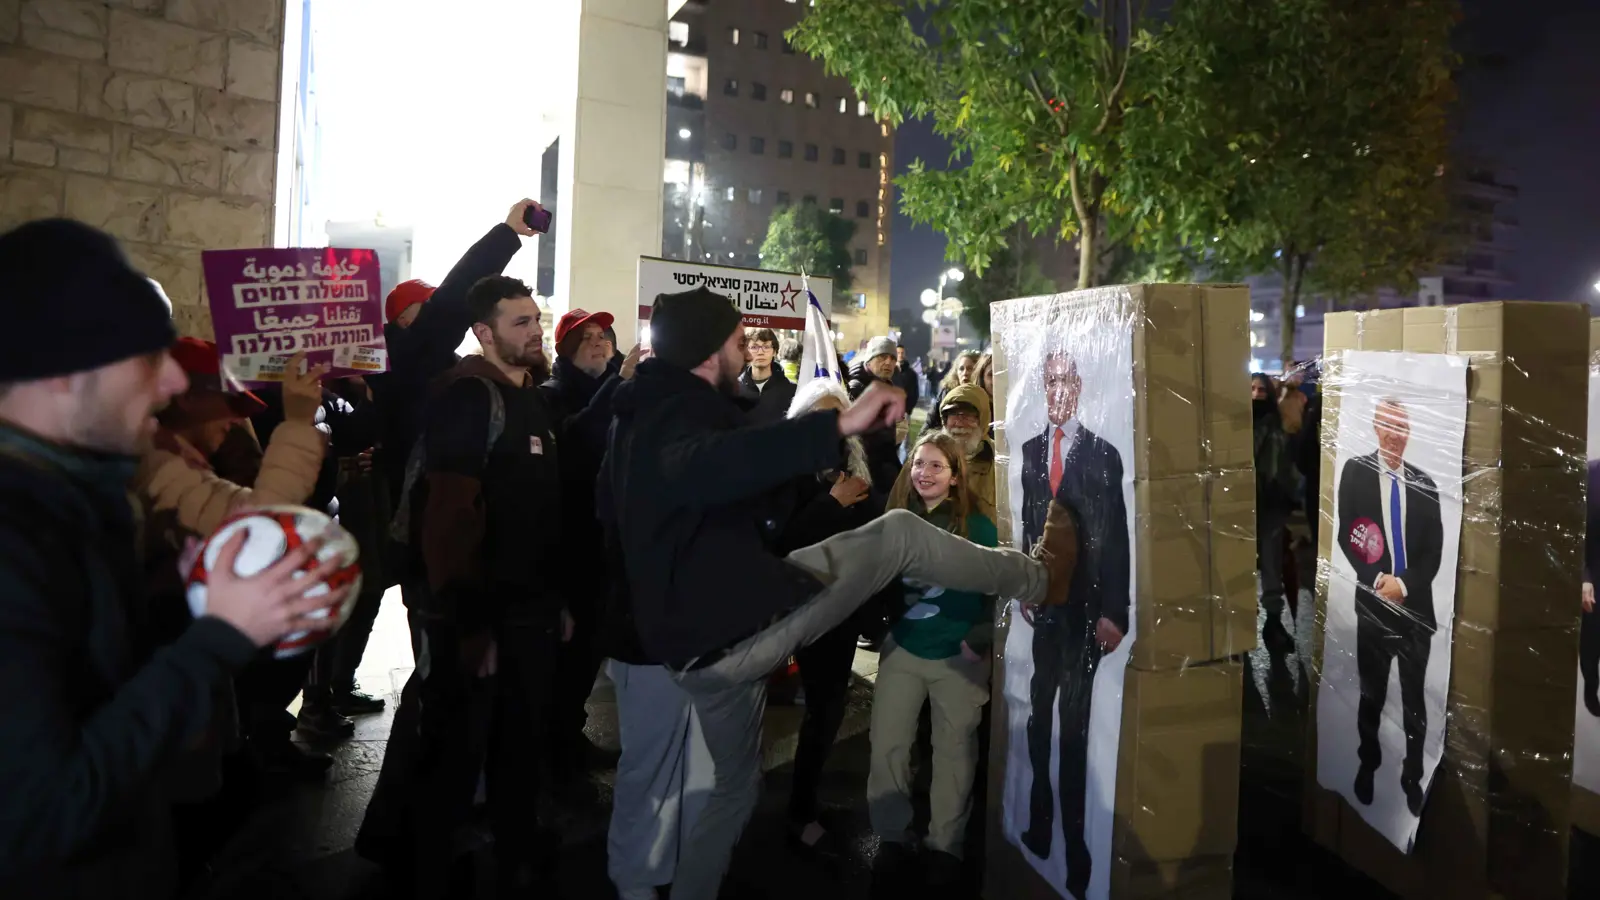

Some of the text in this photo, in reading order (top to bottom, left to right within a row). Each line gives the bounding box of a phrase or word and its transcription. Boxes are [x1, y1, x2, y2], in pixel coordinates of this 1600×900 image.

[243, 256, 360, 285] حكومة دموية
[241, 281, 364, 304] ממשלת דמים
[673, 272, 779, 294] מאבק סוציאליסטי
[746, 294, 778, 310] نضال
[323, 305, 361, 326] تقتلنا
[237, 330, 371, 355] הורגת את כולנו
